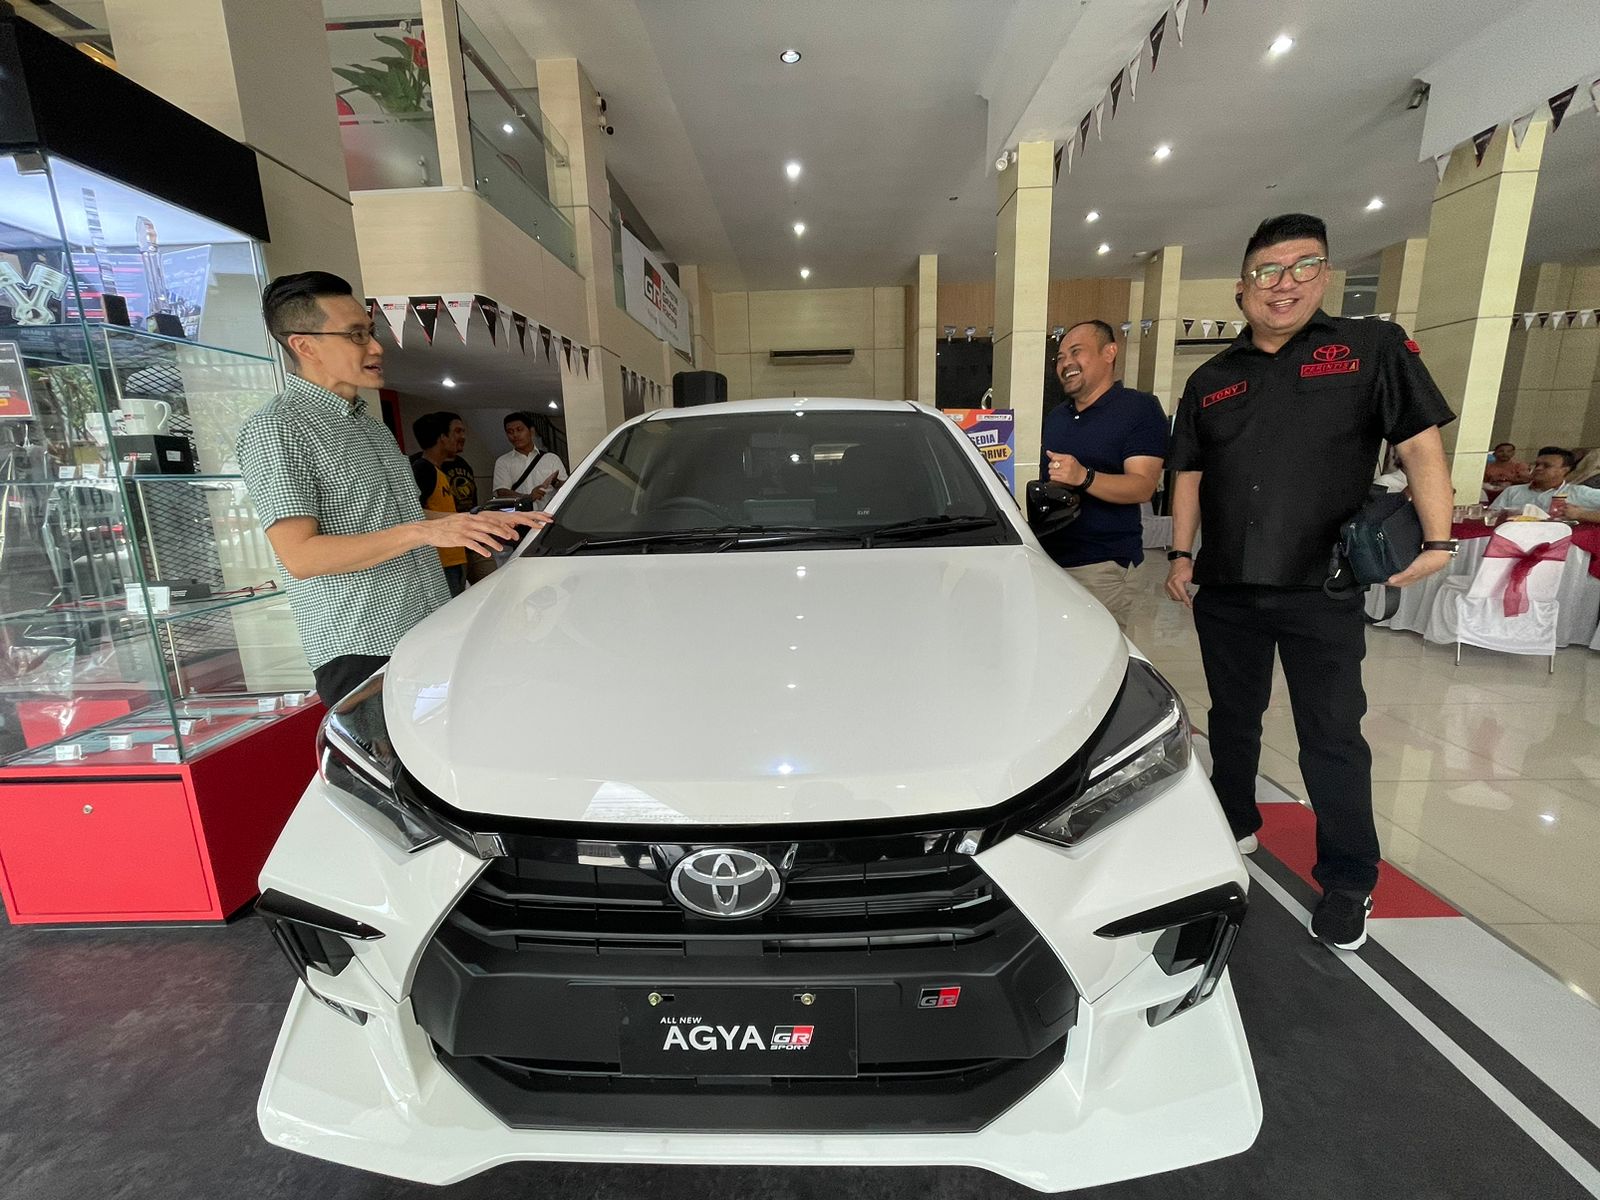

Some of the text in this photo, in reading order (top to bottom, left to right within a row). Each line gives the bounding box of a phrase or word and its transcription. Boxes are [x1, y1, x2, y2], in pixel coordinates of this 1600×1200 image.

[1211, 384, 1238, 401] TONY
[920, 994, 956, 1007] GR
[660, 1016, 702, 1024] ALL NEW
[662, 1025, 811, 1051] AGYA GR
